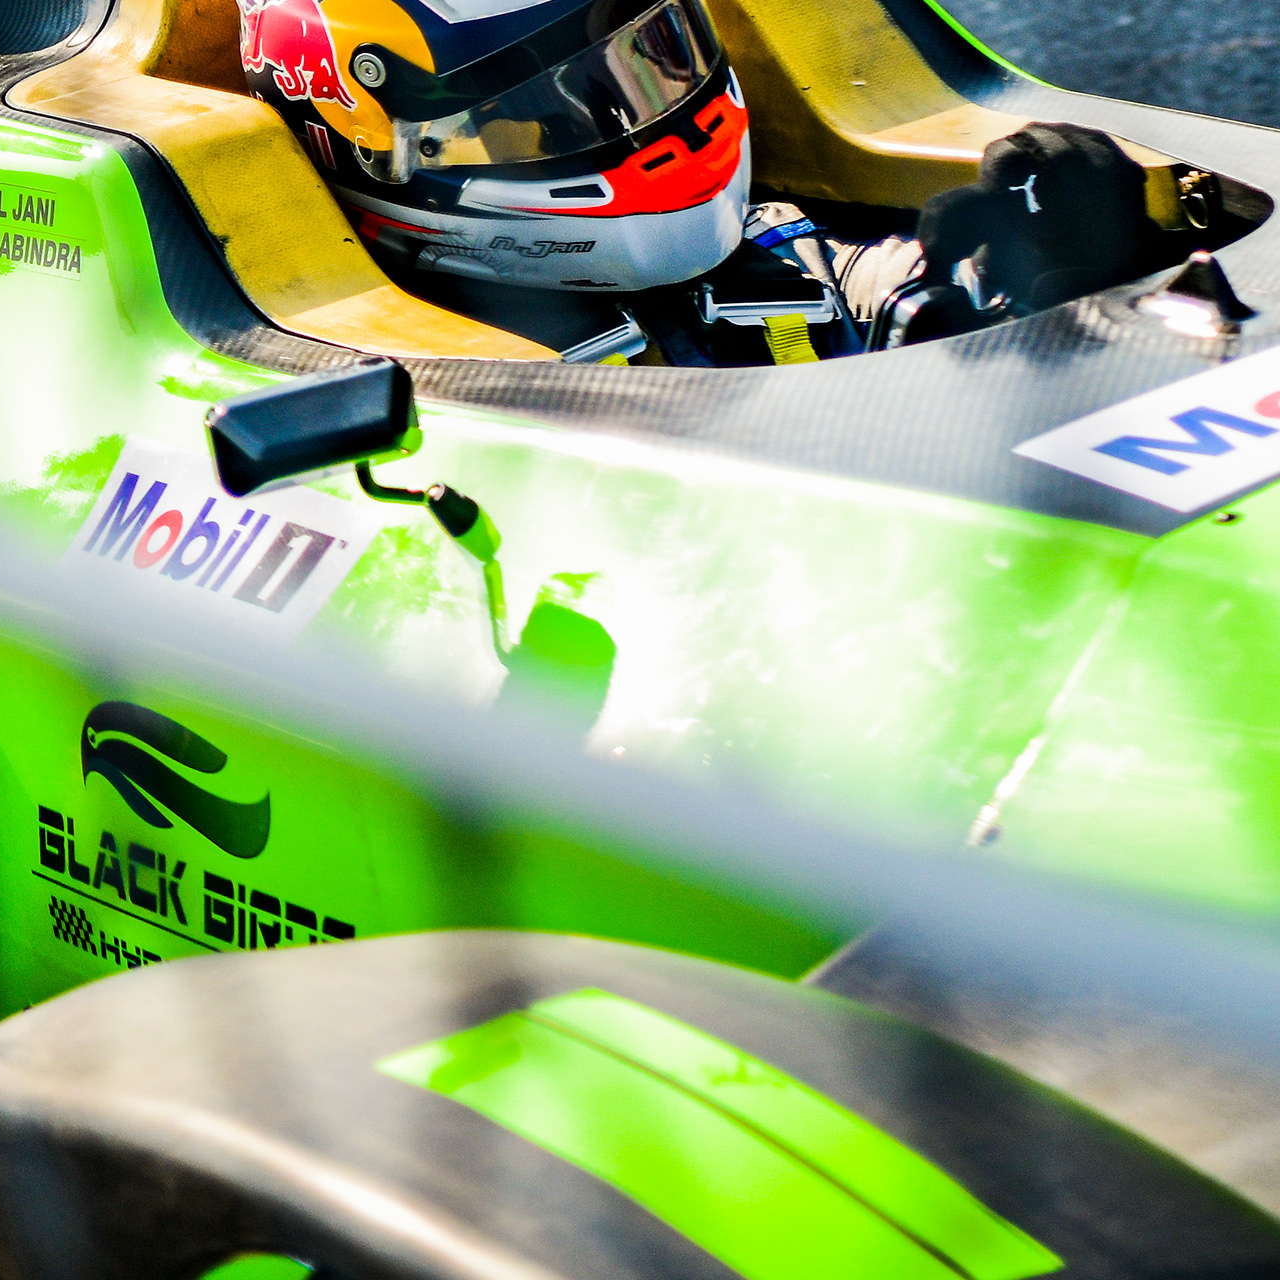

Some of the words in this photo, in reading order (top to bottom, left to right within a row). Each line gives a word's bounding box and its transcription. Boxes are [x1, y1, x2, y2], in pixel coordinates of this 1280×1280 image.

[12, 193, 56, 227] JANI
[82, 472, 271, 592] Mobil
[38, 804, 188, 926] BLACK
